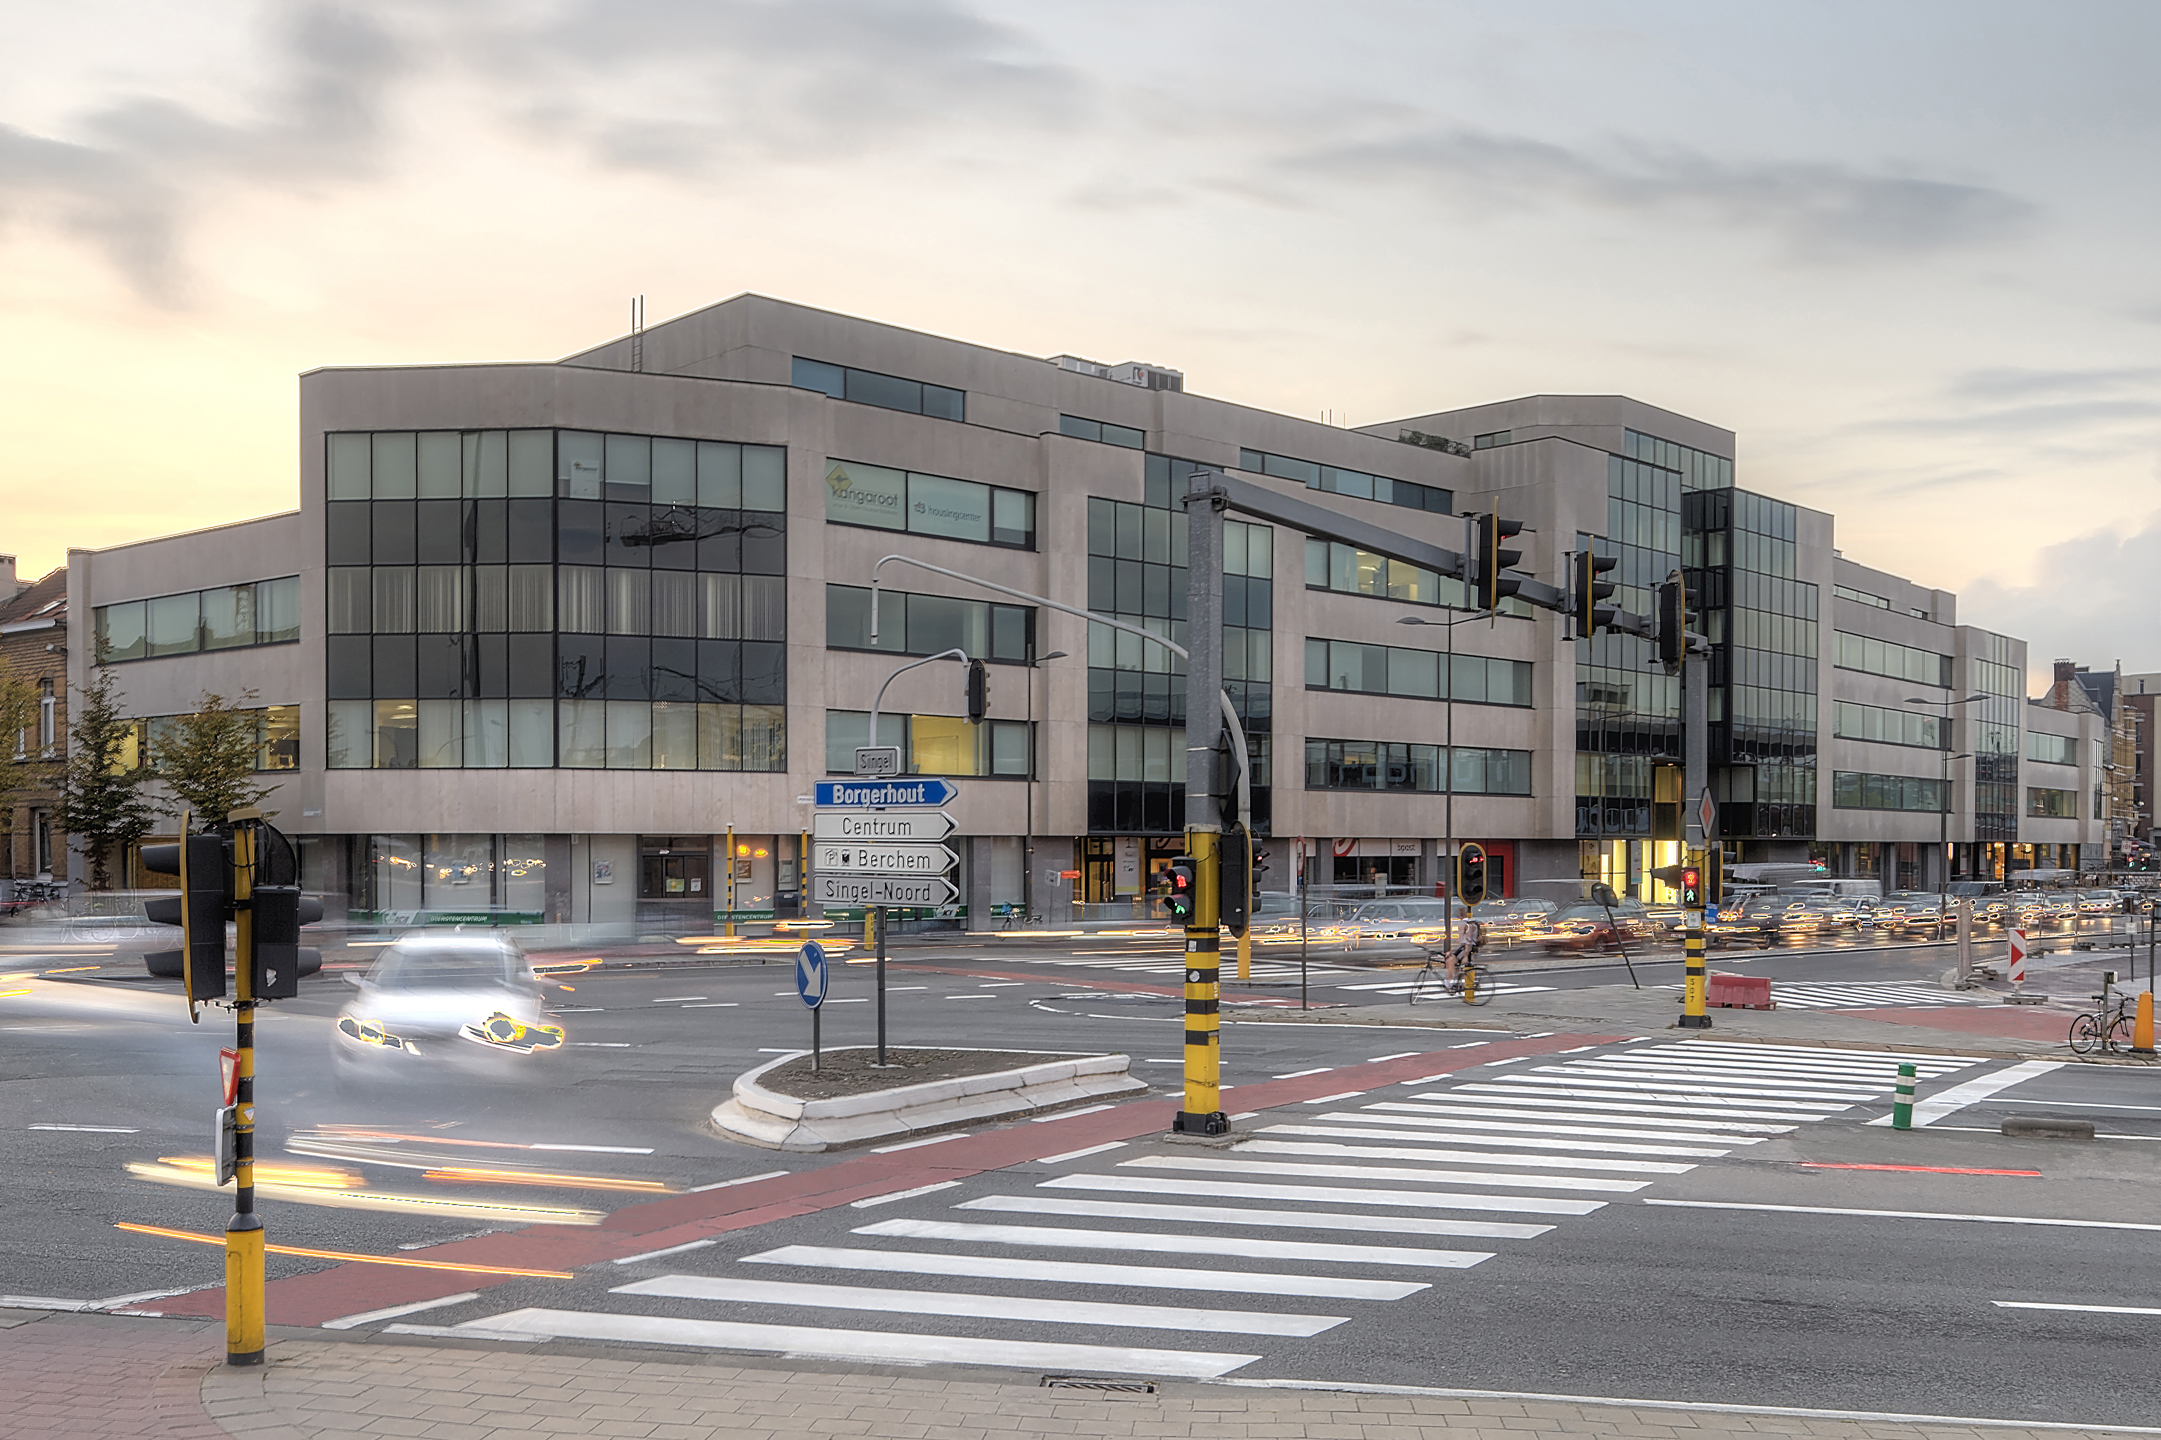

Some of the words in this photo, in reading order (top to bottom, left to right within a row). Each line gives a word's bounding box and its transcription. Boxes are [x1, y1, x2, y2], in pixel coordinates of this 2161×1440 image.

[860, 752, 893, 772] Singel
[833, 783, 925, 807] Borgerhout
[842, 817, 912, 835] Centrum
[859, 849, 930, 869] Berchem
[826, 880, 931, 903] Singel-Noord
